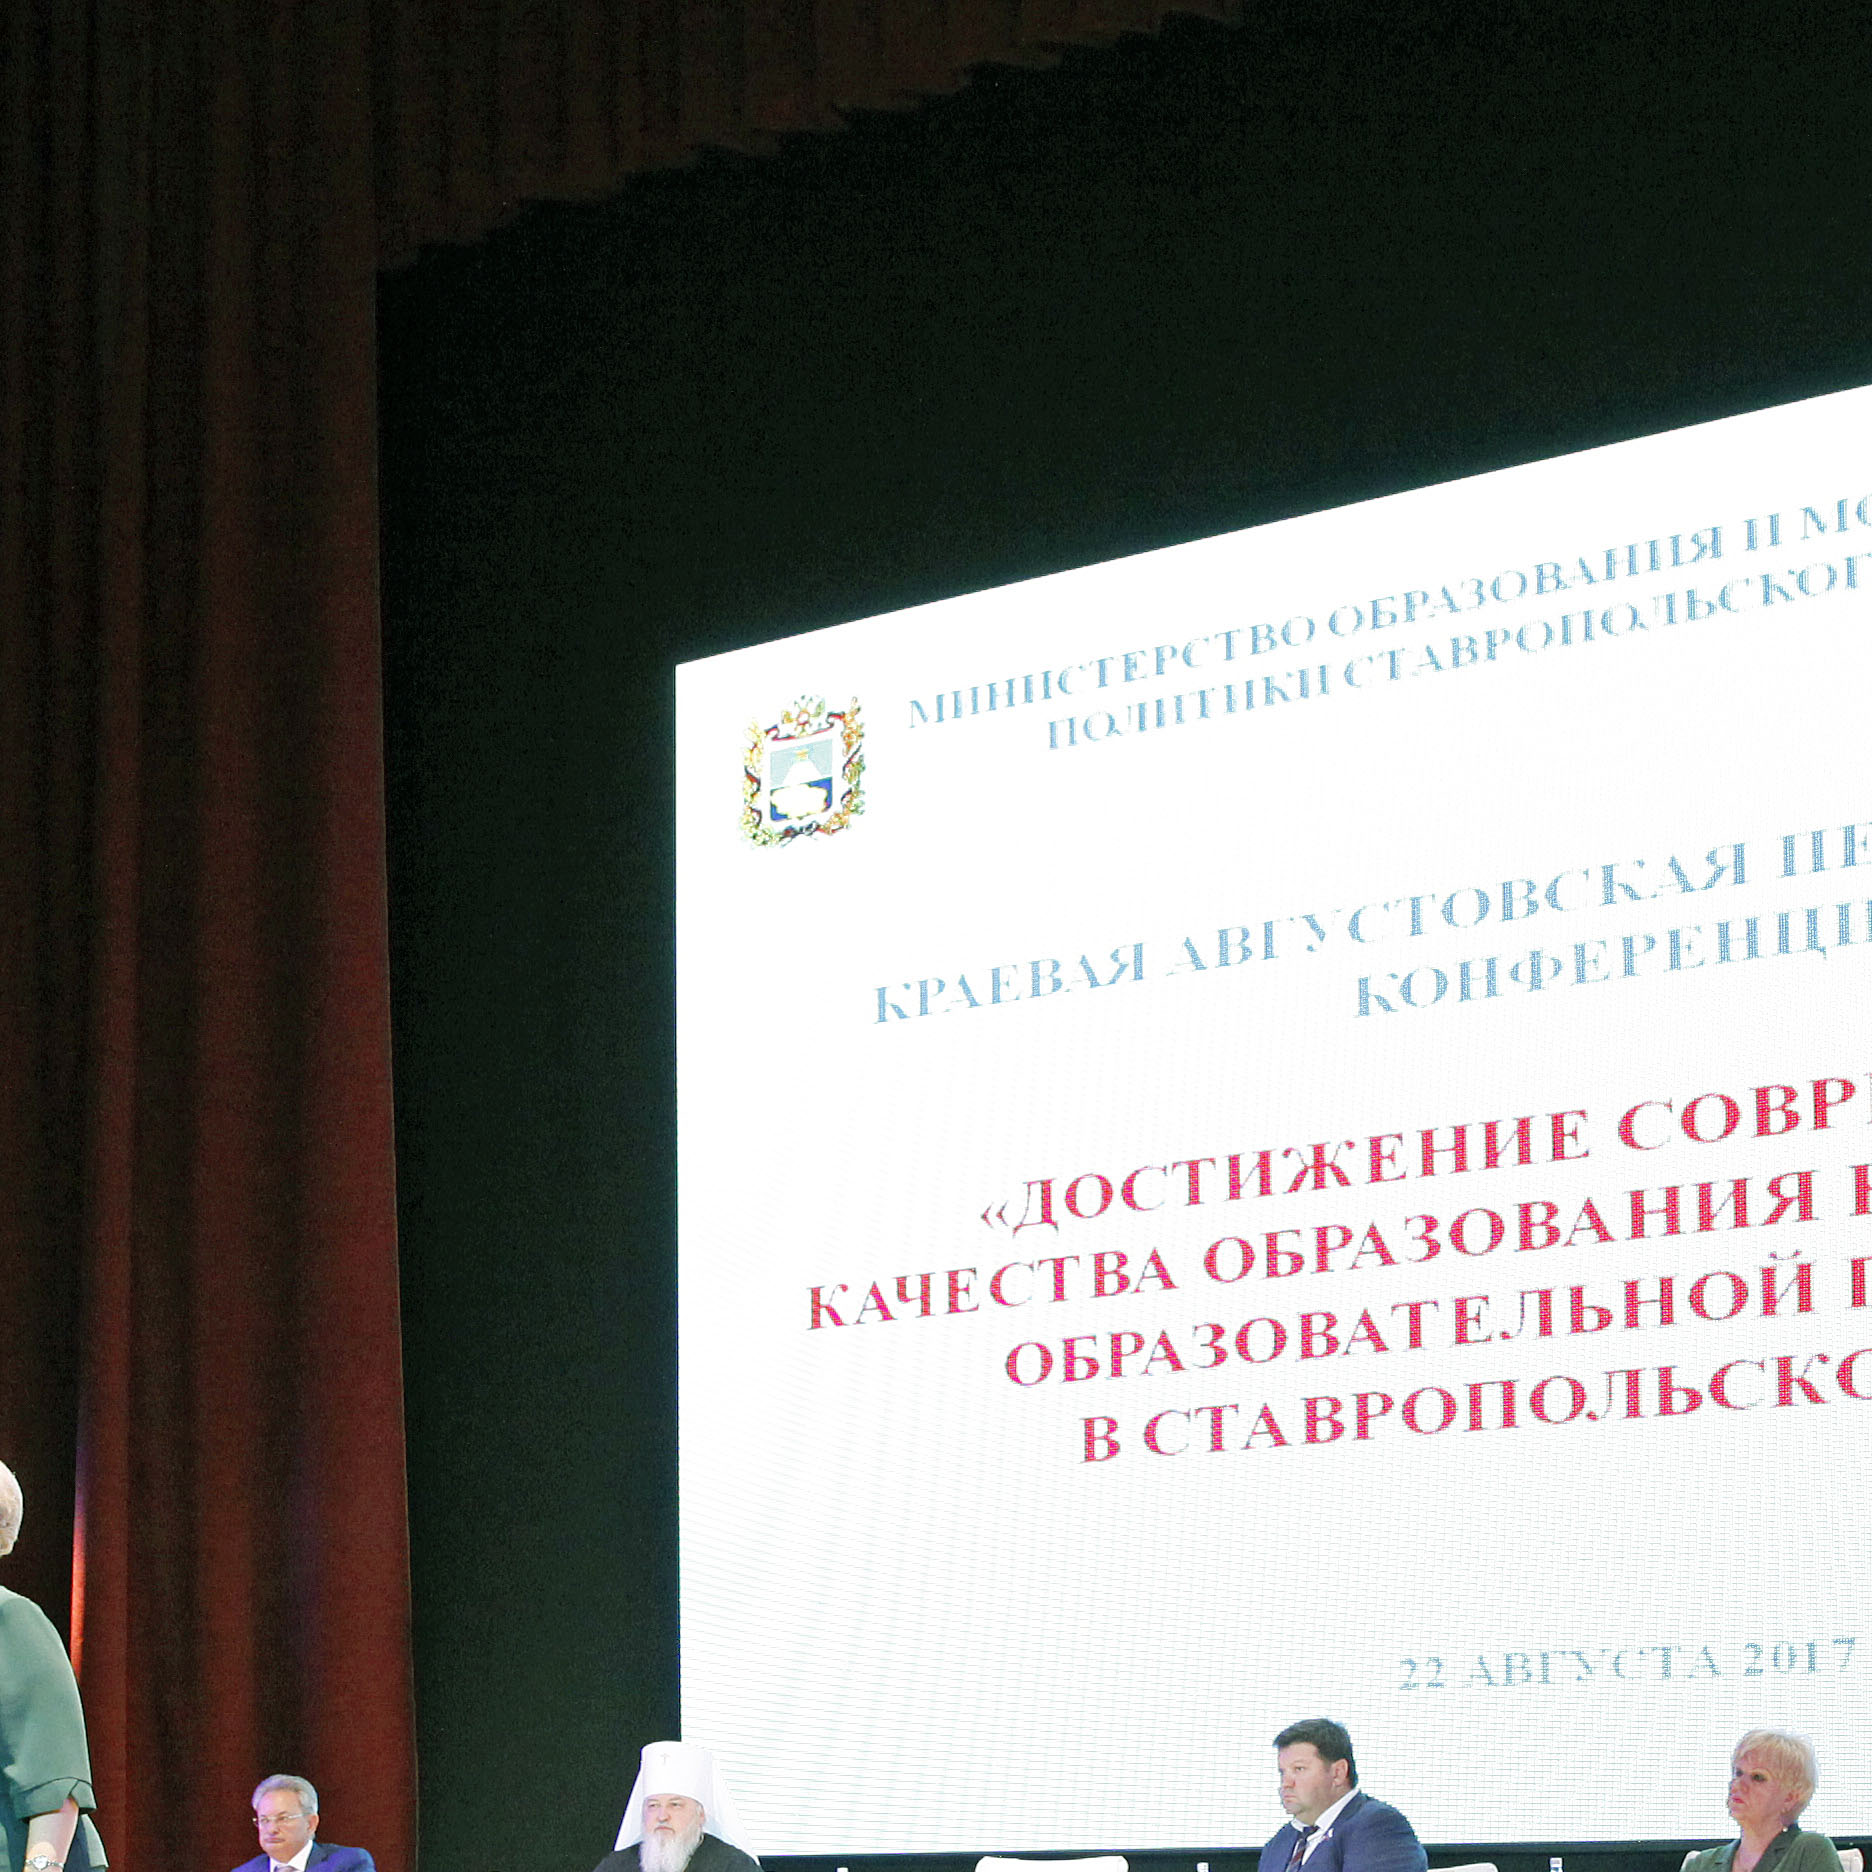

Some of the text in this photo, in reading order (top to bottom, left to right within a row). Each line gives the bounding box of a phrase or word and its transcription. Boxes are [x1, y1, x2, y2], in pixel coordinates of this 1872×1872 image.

[908, 616, 1316, 728] МИНИСТЕРСТВО
[1328, 526, 1724, 638] ОБРАЗОВАНИЯ
[1743, 512, 1783, 552] И
[1047, 663, 1330, 750] ПОЛИТИКИ
[873, 941, 1148, 1024] КРАЕВАЯ
[1164, 841, 1749, 977] АВГУСТОВСКАЯ
[979, 1108, 1591, 1239] «ДОСТИЖЕНИЕ
[805, 1247, 1180, 1331] КАЧЕСТВА
[1201, 1169, 1820, 1286] ОБРАЗОВАНИЯ
[1004, 1249, 1816, 1387] ОБРАЗОВАТЕЛЬНОЙ
[1078, 1415, 1122, 1465] В
[1399, 1656, 1446, 1690] 22
[1462, 1645, 1724, 1688] АВГУСТА
[1742, 1636, 1858, 1678] 2017
